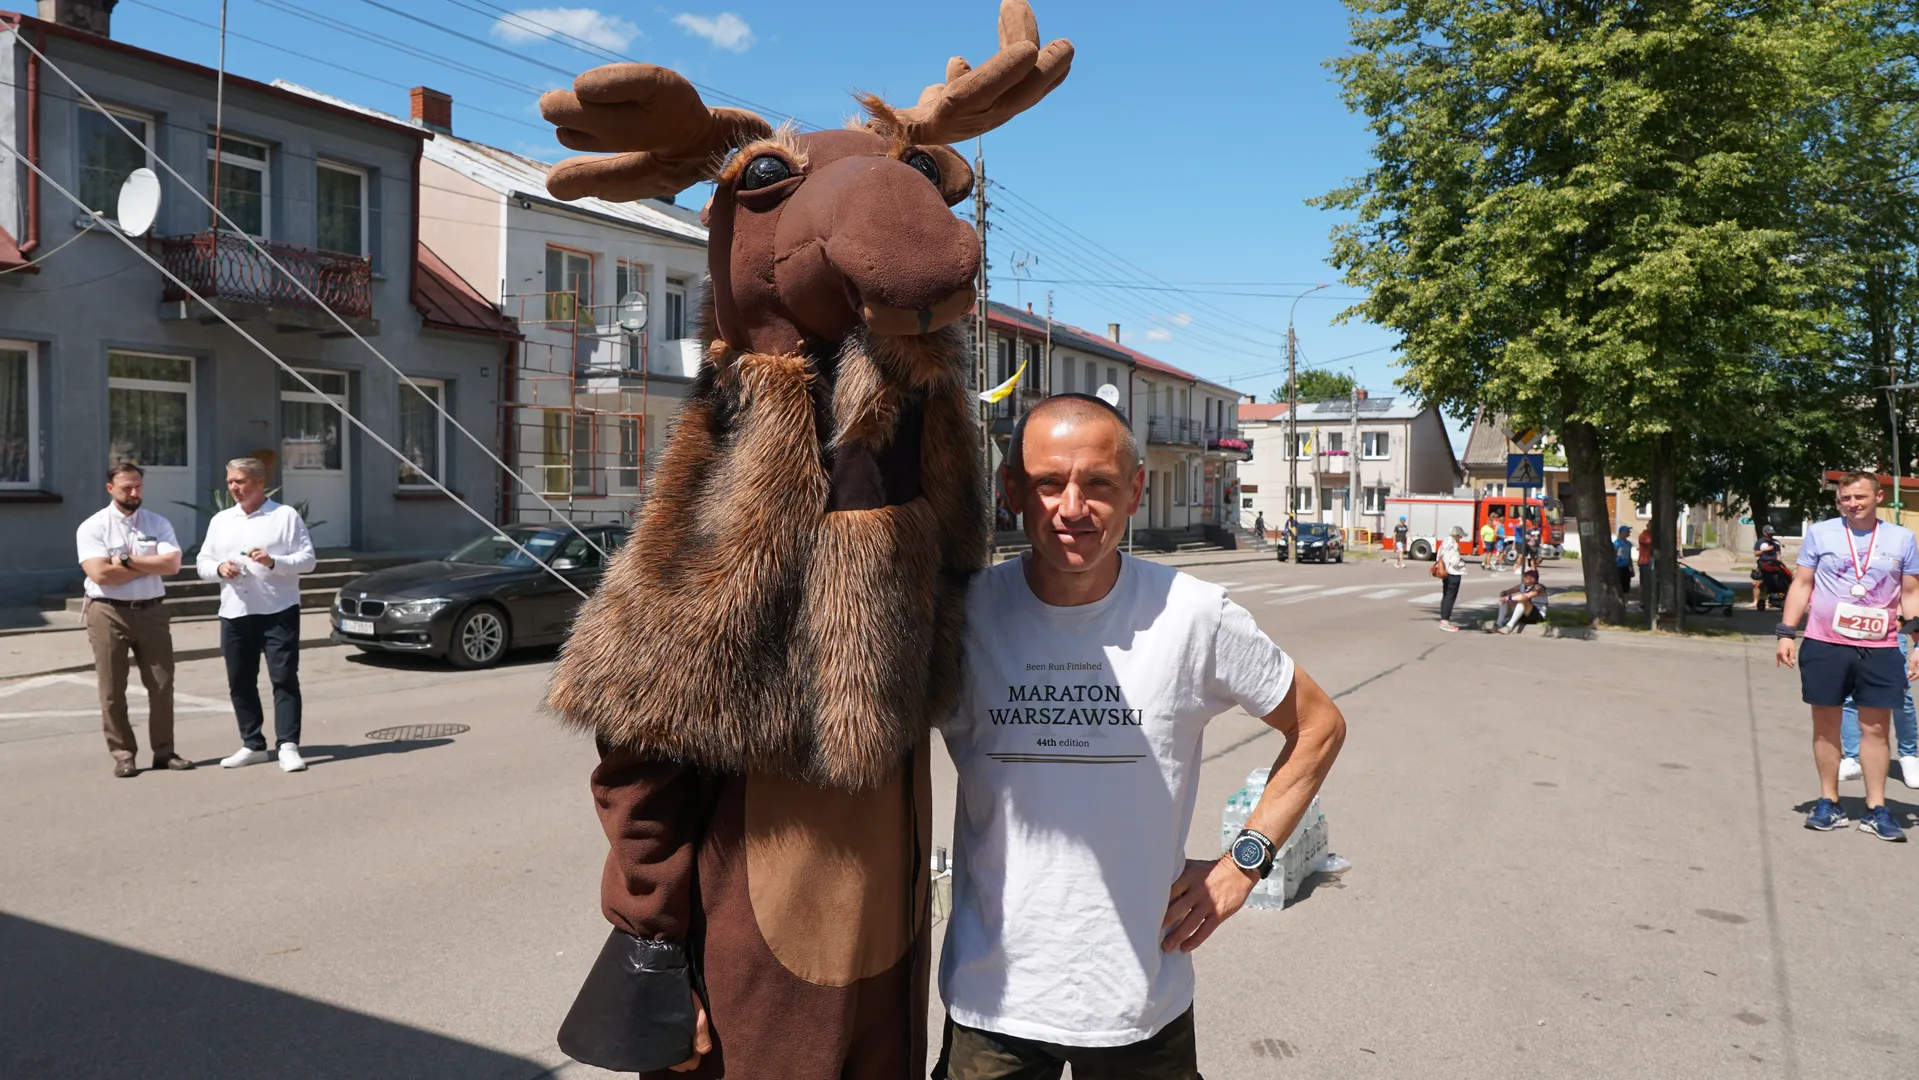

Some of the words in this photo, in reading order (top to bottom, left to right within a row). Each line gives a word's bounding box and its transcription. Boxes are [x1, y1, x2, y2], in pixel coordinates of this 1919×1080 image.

[1850, 616, 1882, 632] 210
[1026, 662, 1046, 671] Been
[1048, 662, 1065, 671] Run
[1066, 662, 1102, 671] Finished
[1008, 685, 1121, 703] MARATON
[988, 708, 1143, 726] WARSZAWSKI
[1036, 738, 1057, 747] 44th
[1058, 738, 1090, 748] edition
[1247, 830, 1271, 846] FINISHER
